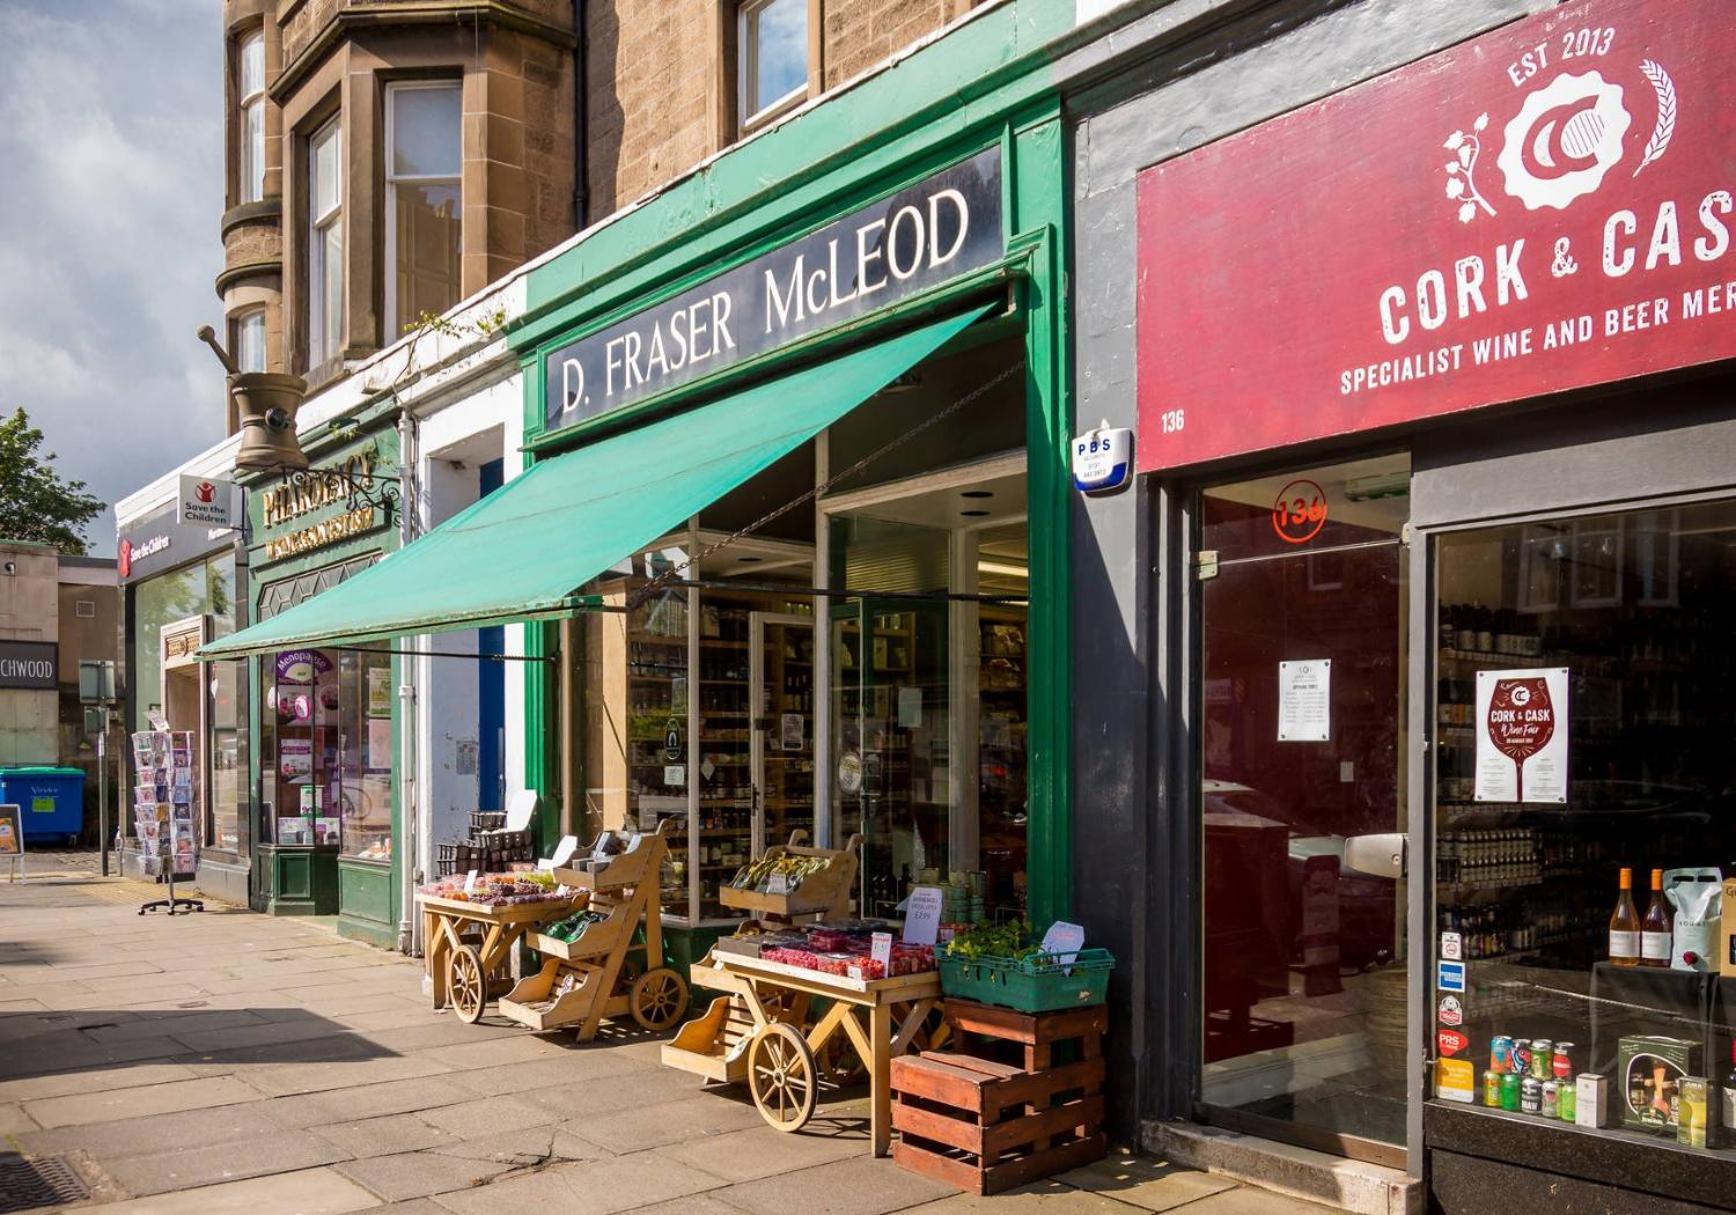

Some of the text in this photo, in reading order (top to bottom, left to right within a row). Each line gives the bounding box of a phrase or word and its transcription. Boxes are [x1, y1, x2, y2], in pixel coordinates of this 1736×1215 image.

[1507, 27, 1615, 88] EST 2013
[561, 187, 969, 414] D. FRASER McLEOD
[1380, 237, 1528, 345] CORK
[1551, 236, 1578, 278] &
[1340, 343, 1463, 395] SPECIALIST
[1472, 327, 1533, 366] WINE
[1543, 315, 1593, 351] AND
[1605, 298, 1669, 337] BEER
[1161, 409, 1185, 433] 136
[184, 511, 227, 524] Children
[185, 502, 226, 514] Save the
[1279, 494, 1324, 527] 136
[1491, 709, 1516, 722] CORK
[1525, 709, 1550, 722] CASK
[1439, 1033, 1460, 1046] PRS
